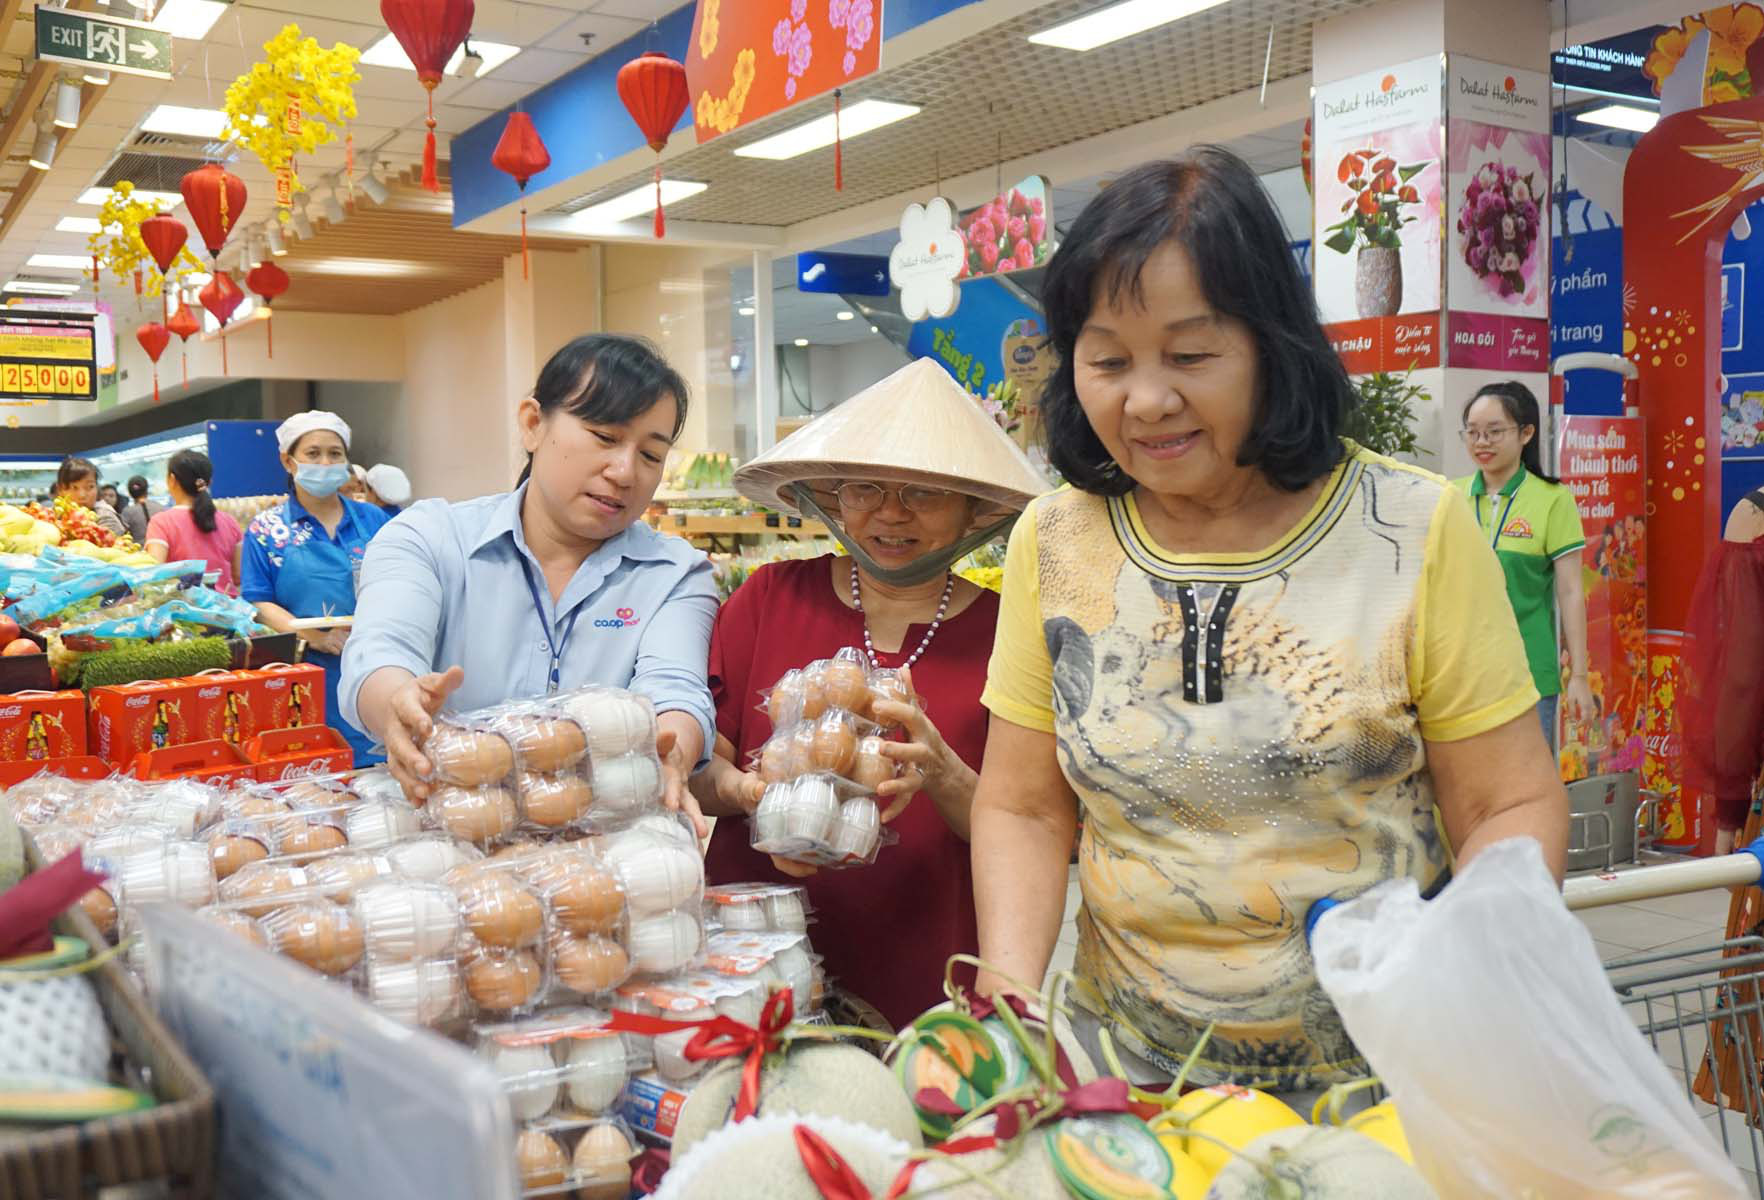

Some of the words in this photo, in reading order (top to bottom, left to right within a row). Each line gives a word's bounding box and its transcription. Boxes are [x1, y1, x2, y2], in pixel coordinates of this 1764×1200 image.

[51, 25, 84, 48] EXIT
[1583, 46, 1597, 59] TIN
[1459, 76, 1488, 97] Dalat
[1323, 92, 1360, 119] Dalat
[1561, 266, 1607, 295] phẩm
[1455, 331, 1475, 345] HOA
[1477, 331, 1495, 346] GÓI
[1561, 323, 1603, 343] trang
[1342, 335, 1372, 353] CHẬU
[933, 327, 973, 383] Tầng
[971, 361, 986, 388] 2
[1569, 480, 1590, 496] hào
